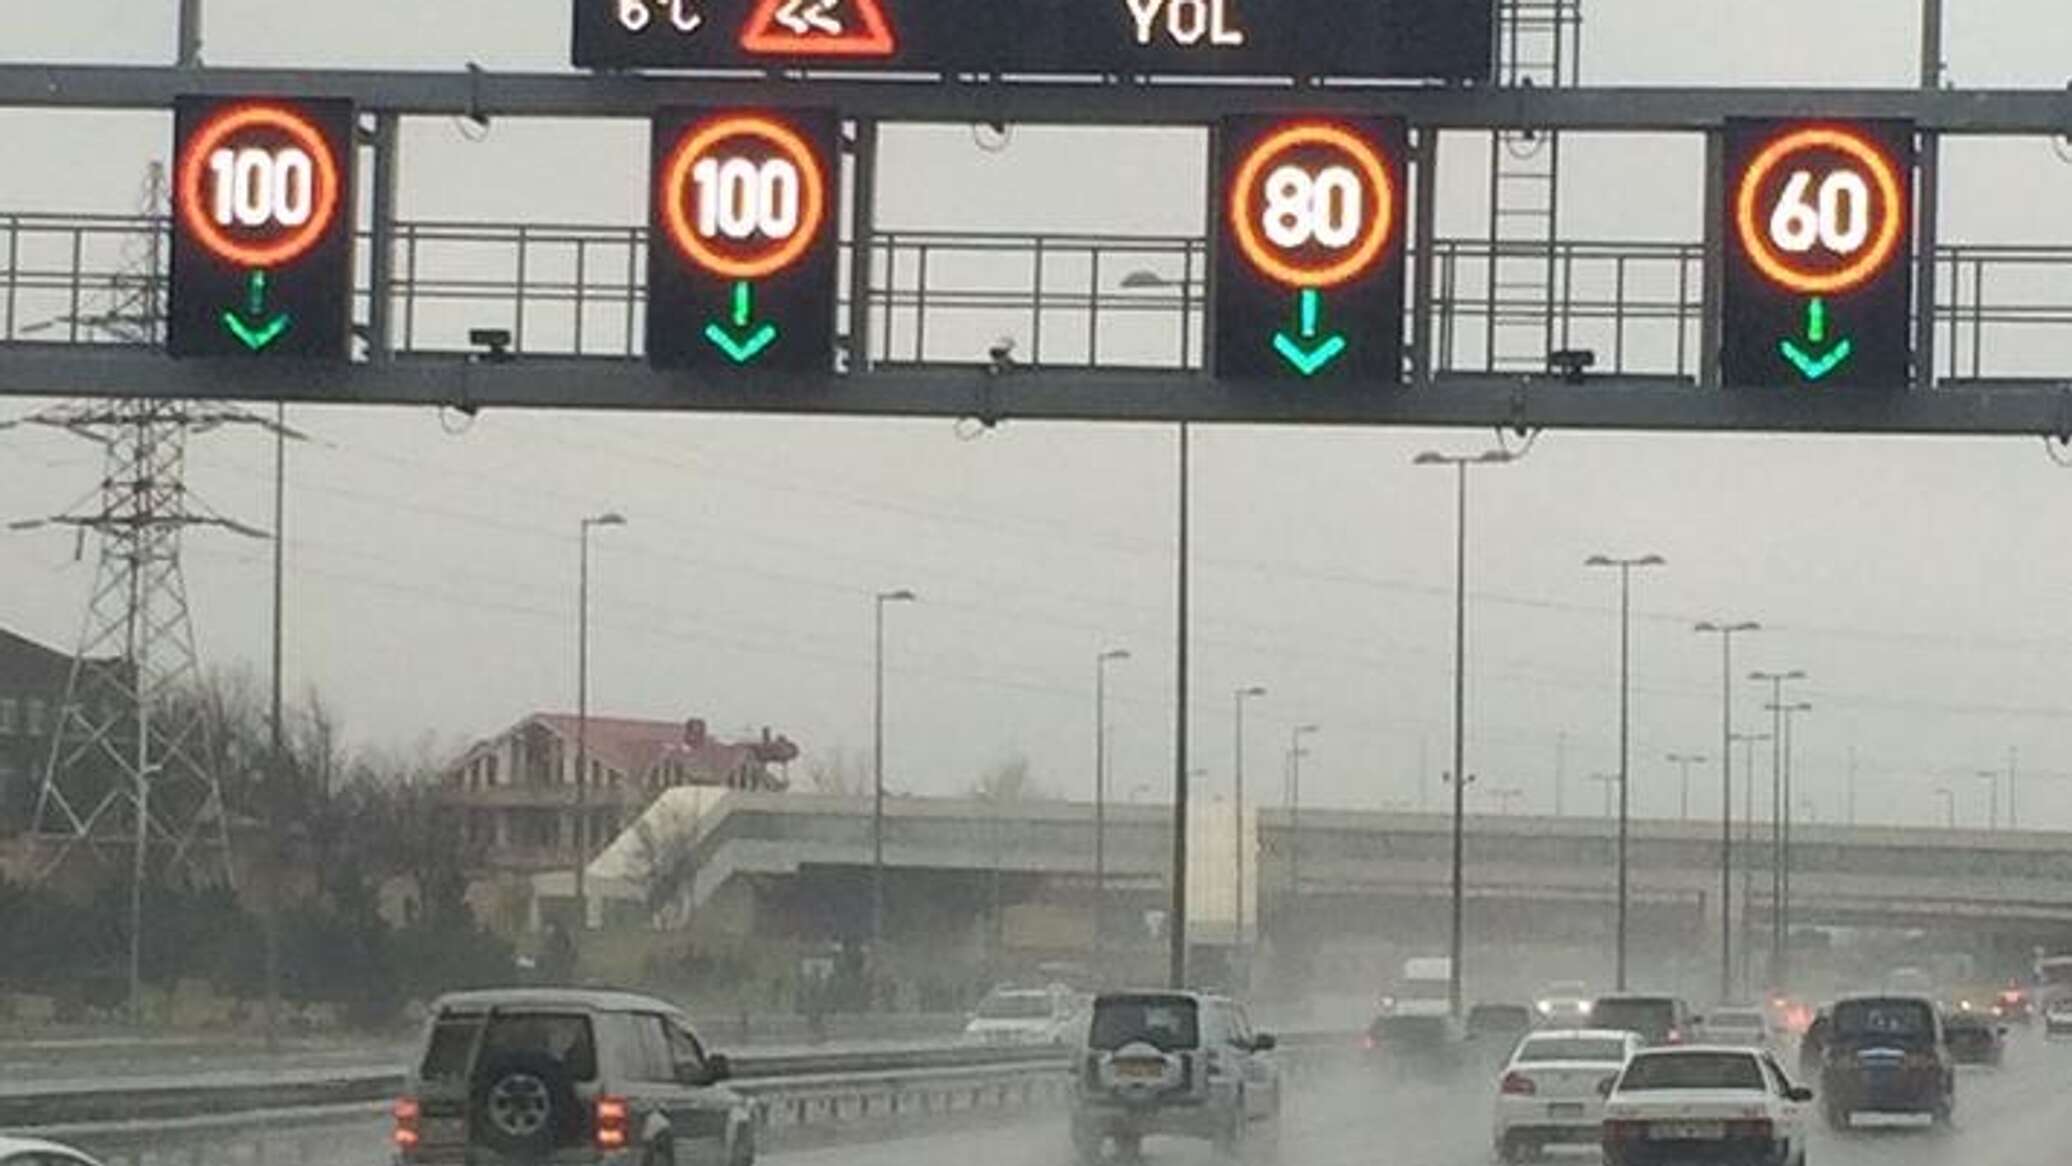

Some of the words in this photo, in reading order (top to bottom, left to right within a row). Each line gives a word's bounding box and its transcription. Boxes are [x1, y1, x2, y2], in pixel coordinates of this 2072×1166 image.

[1125, 0, 1244, 45] YOL
[210, 147, 313, 227] 100
[693, 156, 800, 240] 100
[1262, 165, 1362, 249] 80
[1770, 169, 1869, 254] 60
